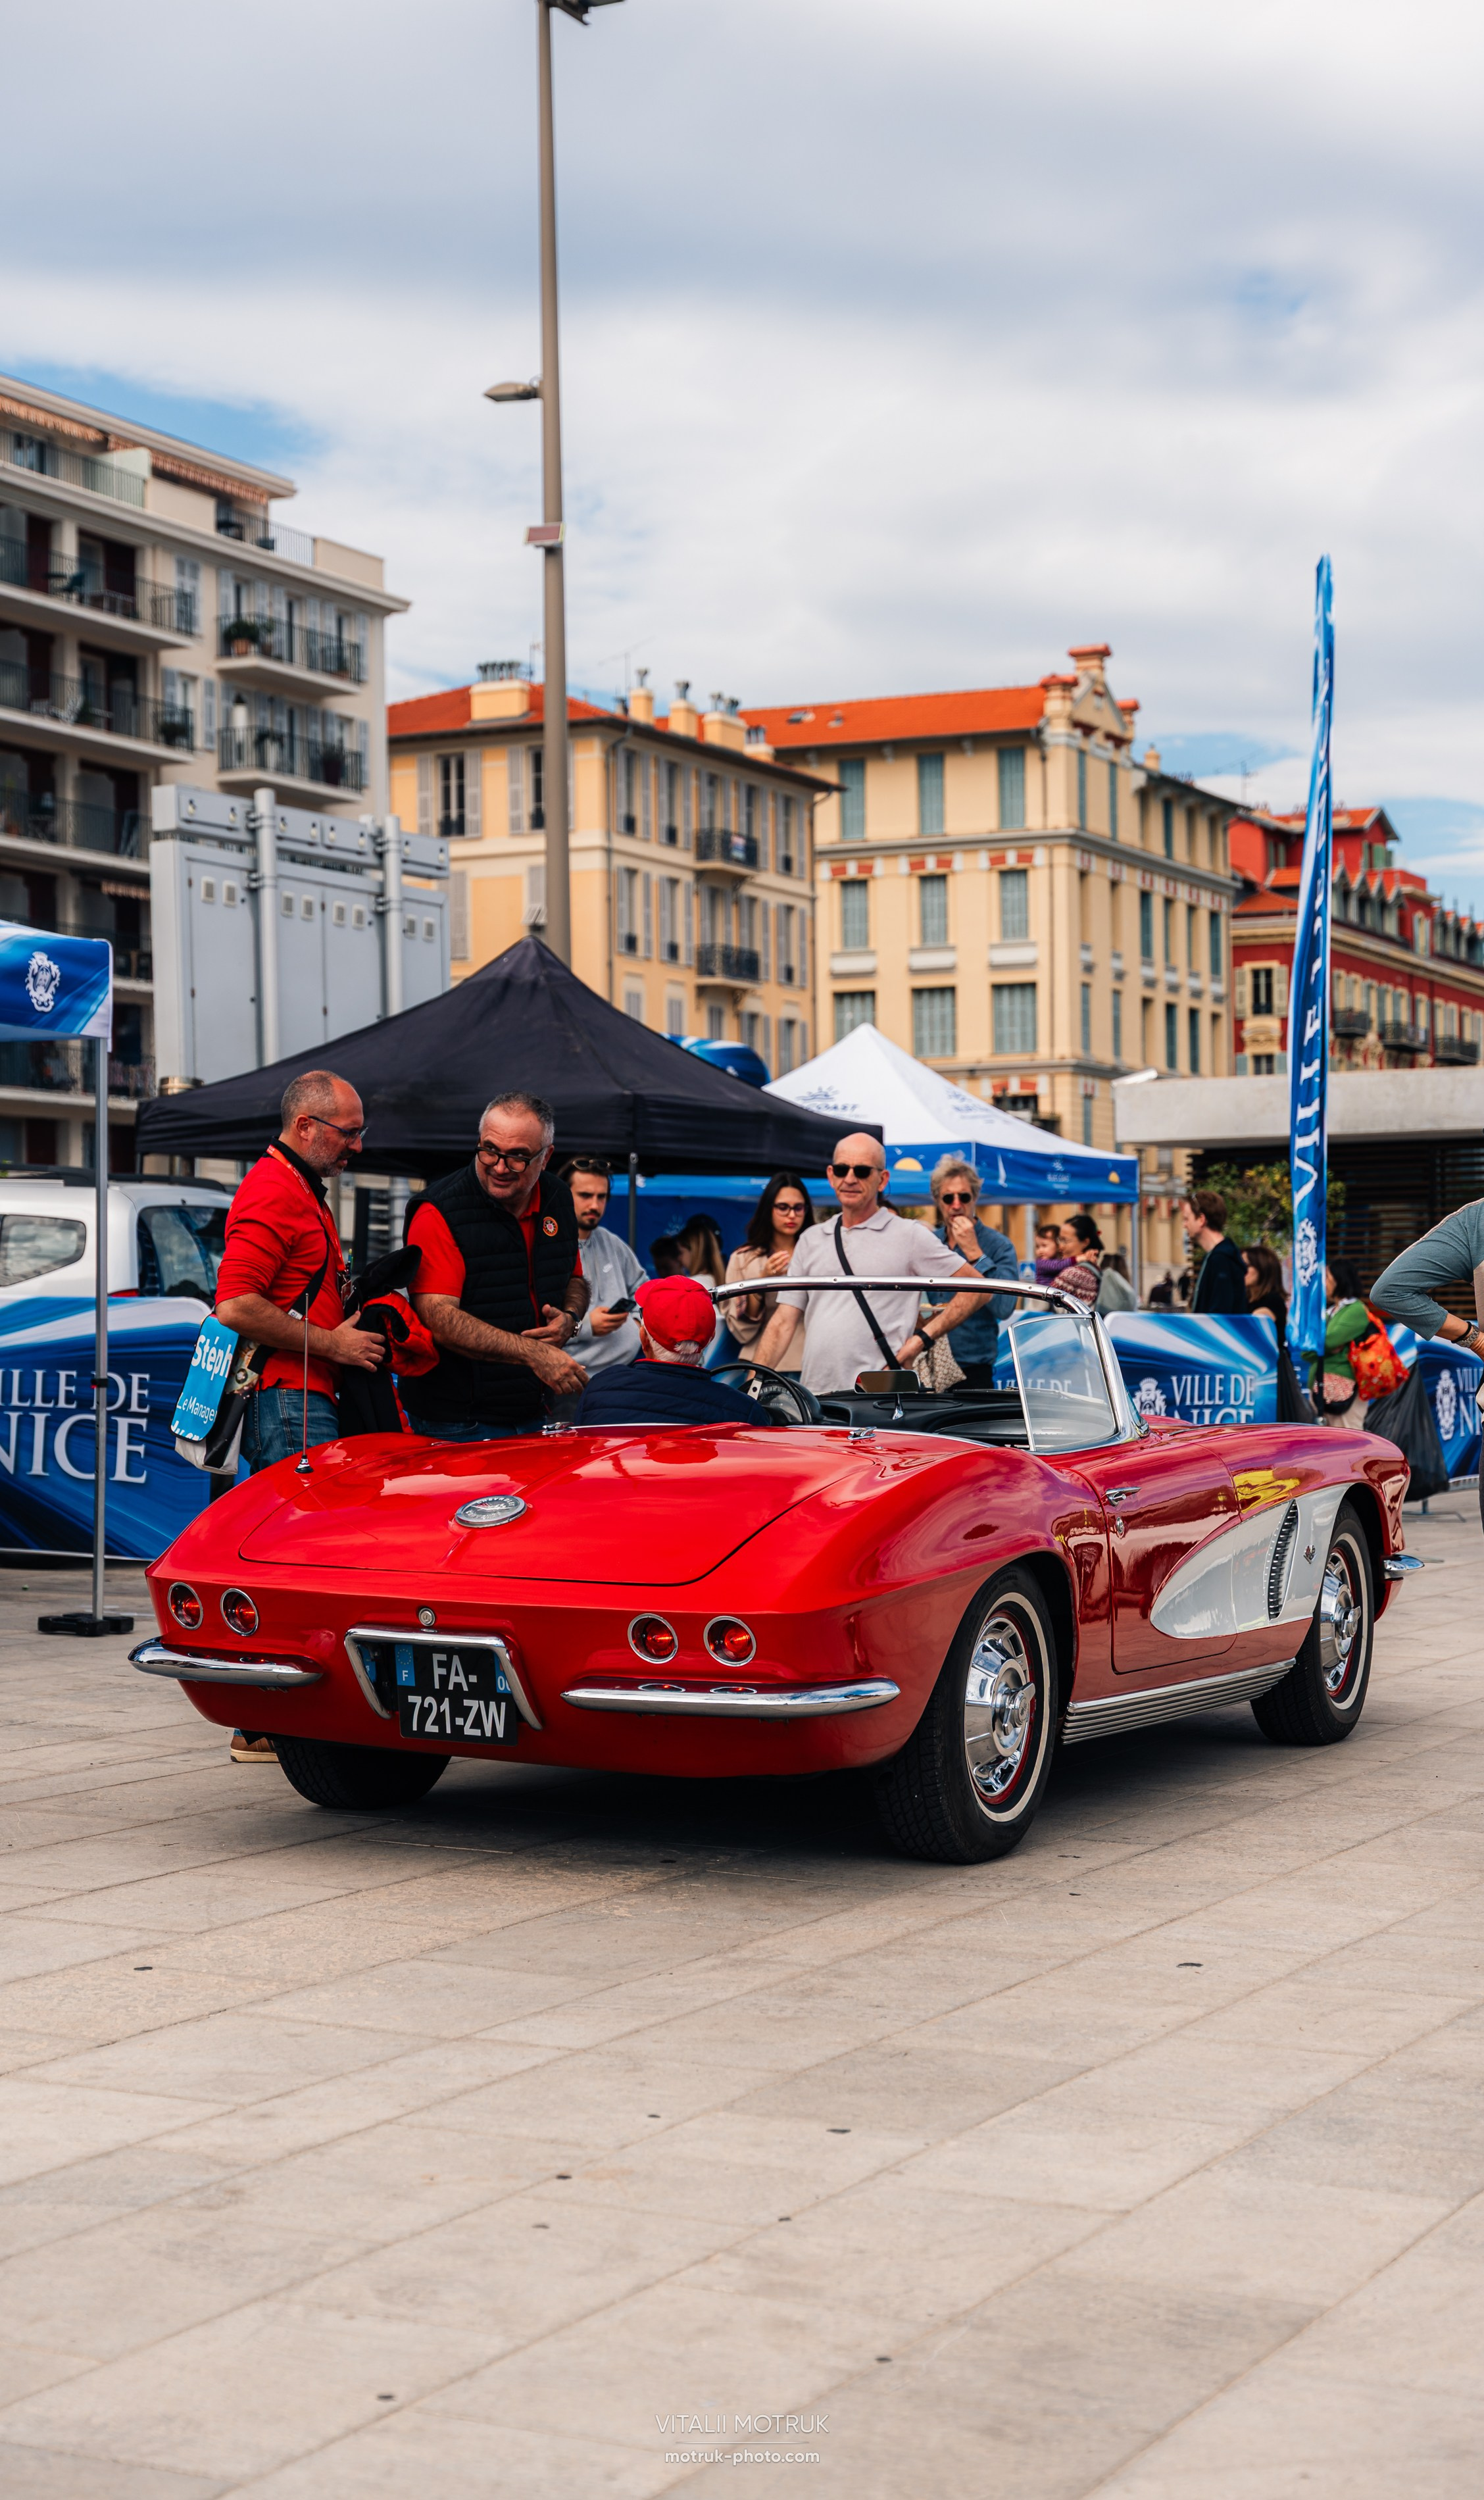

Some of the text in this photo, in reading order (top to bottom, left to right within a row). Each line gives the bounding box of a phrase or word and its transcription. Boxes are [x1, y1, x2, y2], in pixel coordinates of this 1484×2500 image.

[1293, 997, 1322, 1214] VILLE
[90, 1370, 151, 1413] DE
[176, 1392, 188, 1411] Le
[1171, 1374, 1224, 1406] VILLE
[1229, 1374, 1256, 1407] DE
[402, 1670, 408, 1682] F
[432, 1653, 478, 1691] FA-
[408, 1695, 506, 1738] 721-ZW
